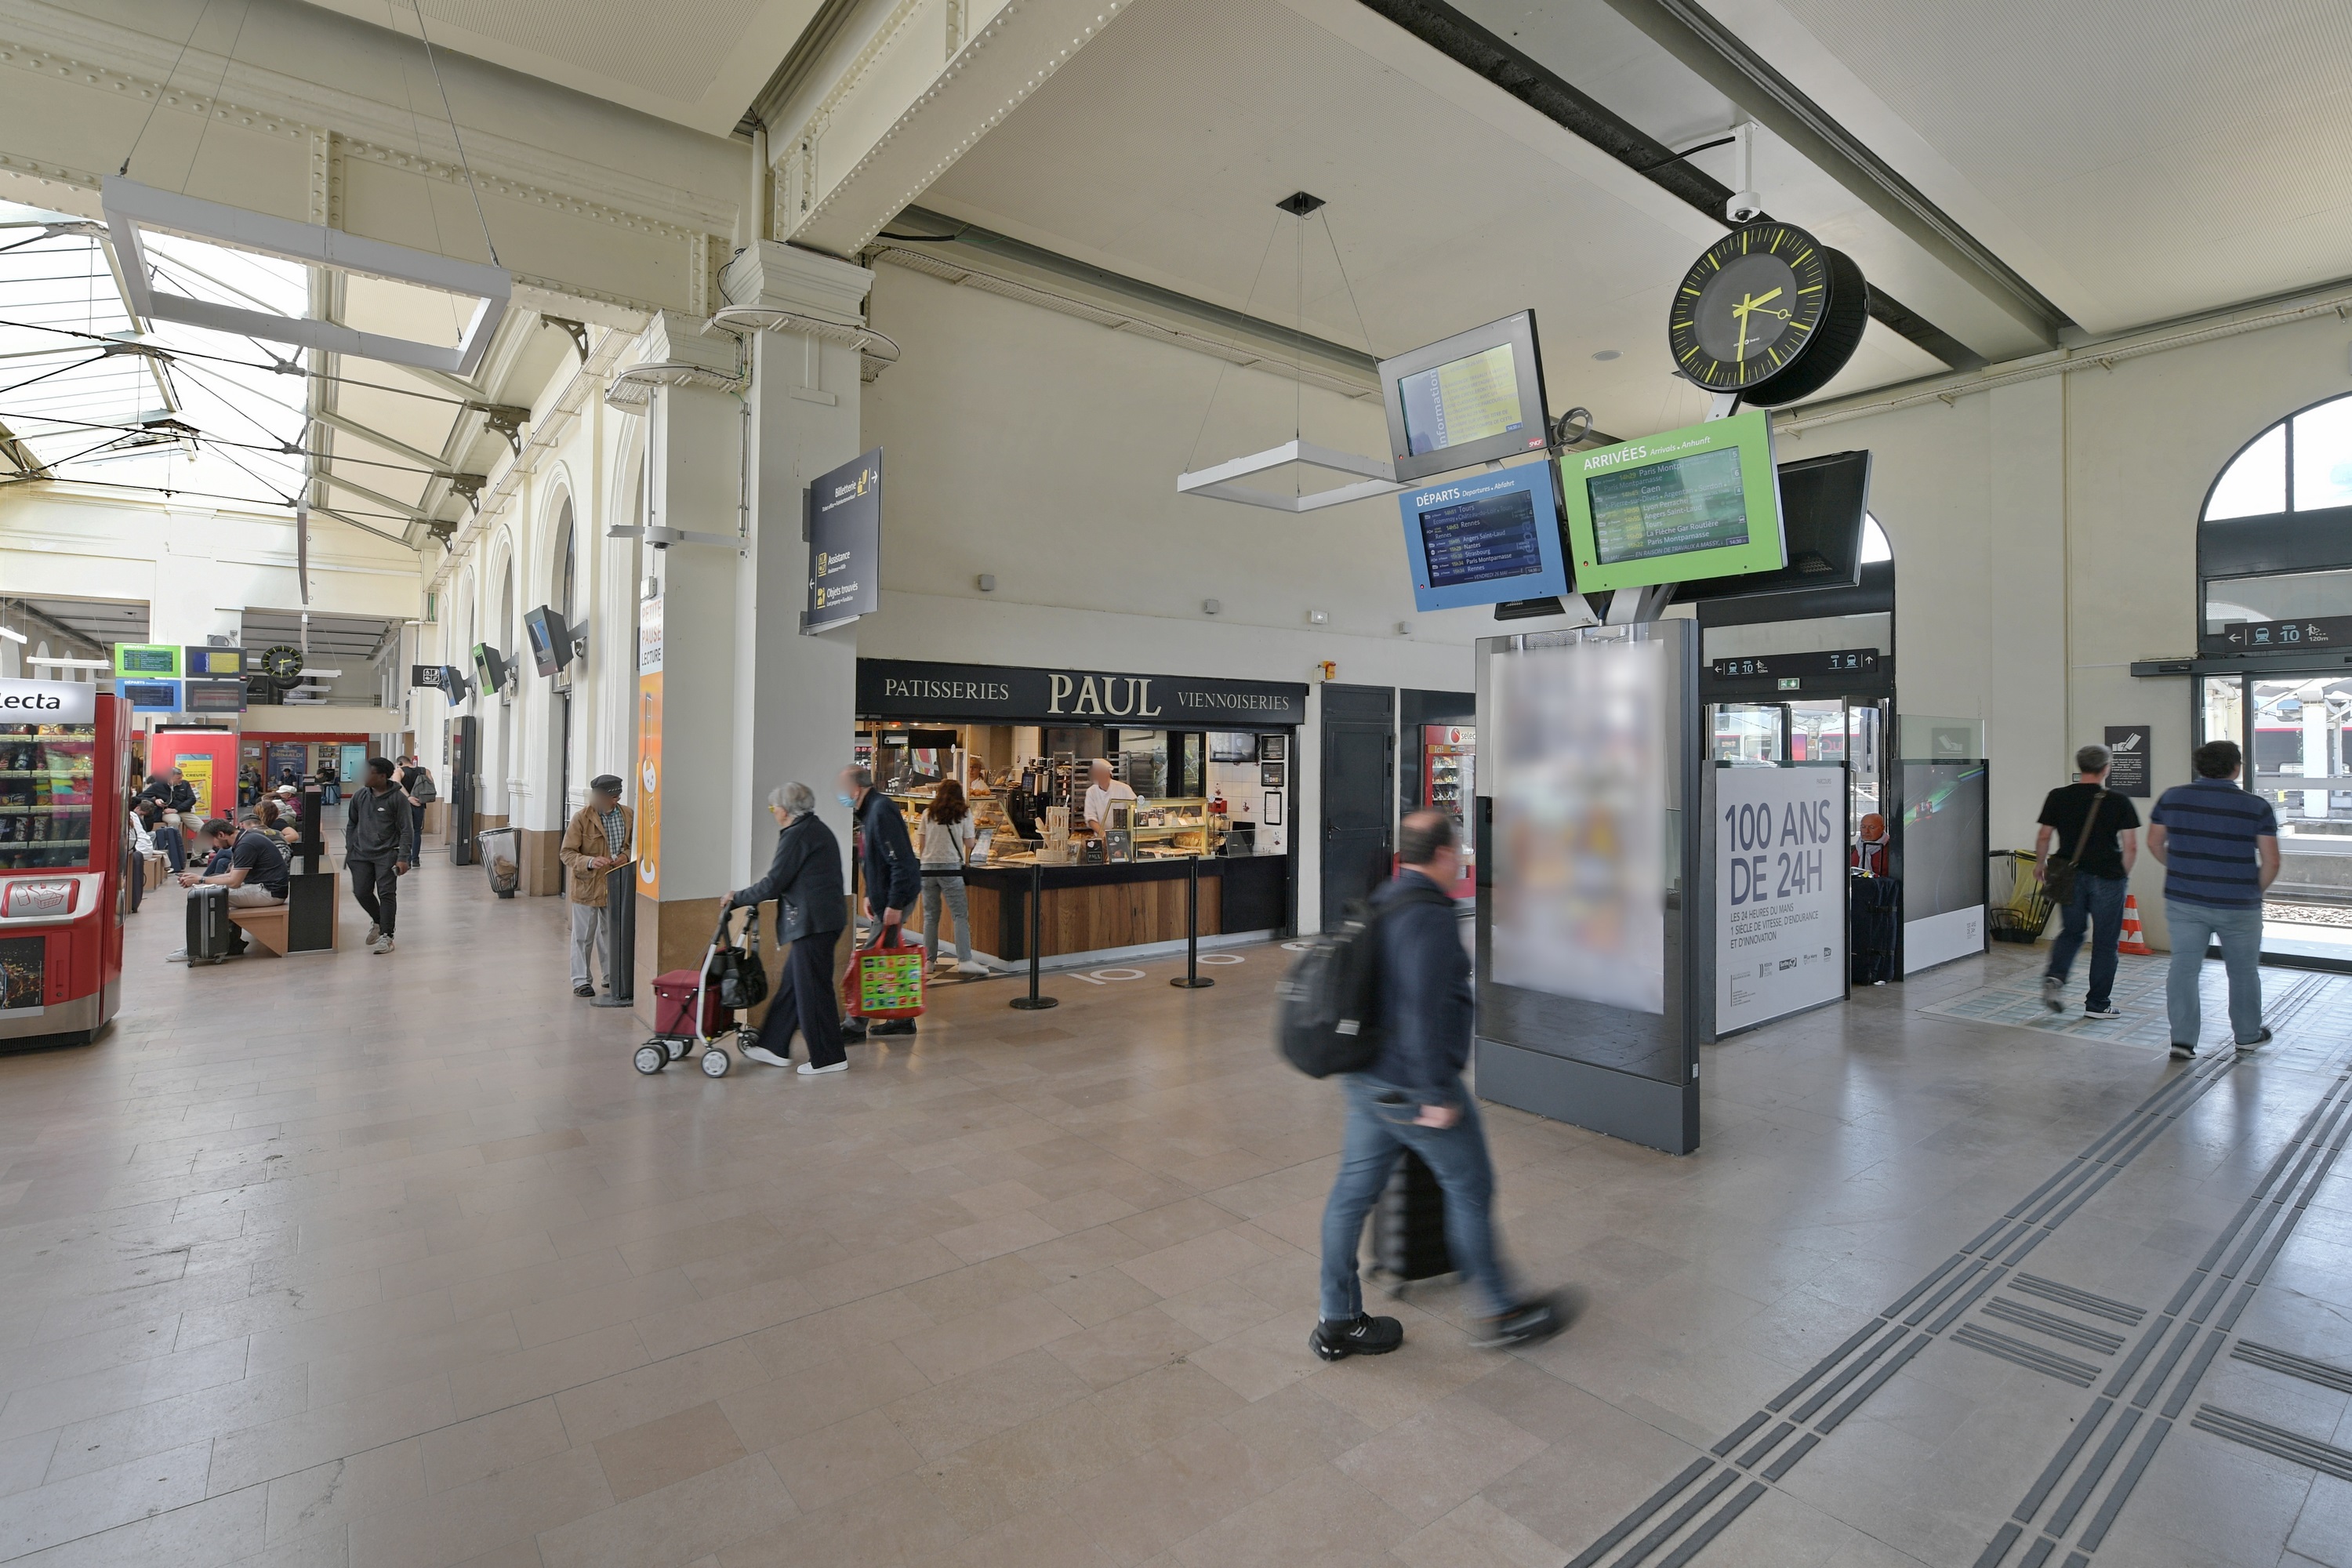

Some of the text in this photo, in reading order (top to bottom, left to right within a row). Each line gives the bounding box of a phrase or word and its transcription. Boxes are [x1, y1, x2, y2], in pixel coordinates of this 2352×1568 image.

[1429, 369, 1447, 448] information
[1529, 439, 1543, 448] SNCF
[1584, 445, 1647, 470] ARRIVÉES
[1650, 445, 1676, 456] Arrivals
[1639, 467, 1656, 477] Paris
[835, 481, 856, 498] Billetterie
[1619, 474, 1662, 489] Montparnasse
[1641, 484, 1661, 494] Caen
[1664, 487, 1693, 499] Argentan
[1698, 481, 1722, 492] Surdon
[1416, 480, 1515, 507] DÉPARTS Departures Abfahrt
[1459, 504, 1475, 513] Tours
[1643, 503, 1658, 512] Lyon
[1644, 510, 1666, 521] Angers
[1667, 503, 1702, 516] Saint-Laud
[1461, 518, 1480, 528] Rennes
[1645, 520, 1662, 528] Tours
[1655, 526, 1675, 535] Flèche
[1690, 519, 1719, 530] Routière
[1463, 534, 1479, 543] Angers
[1479, 528, 1505, 539] Saint-Laud
[1664, 530, 1710, 544] Montparnasse
[827, 551, 851, 565] Assistance
[1465, 548, 1490, 558] Strasbourg
[1479, 551, 1512, 564] Montparnasse
[826, 581, 858, 599] Objets trouvés
[642, 600, 662, 623] PETITE
[642, 624, 662, 647] PAUSE
[2280, 630, 2299, 641] 10
[641, 648, 661, 666] LECTURE
[1742, 664, 1753, 673] 10
[884, 679, 1009, 700] PATISSERIES
[1047, 673, 1162, 717] PAUL
[1178, 691, 1289, 710] VIENNOISERIES
[1725, 799, 1831, 852] 100 ANS
[1730, 848, 1823, 906] DE 24H
[1730, 902, 1794, 923] LES 24 HEURES DU MANS
[1735, 922, 1752, 935] SIÈCLE
[1753, 920, 1762, 931] DE
[1762, 916, 1784, 929] VITESSE,
[1784, 910, 1819, 925] D'ENDURANCE
[1730, 931, 1777, 949] ET D'INNOVATION
